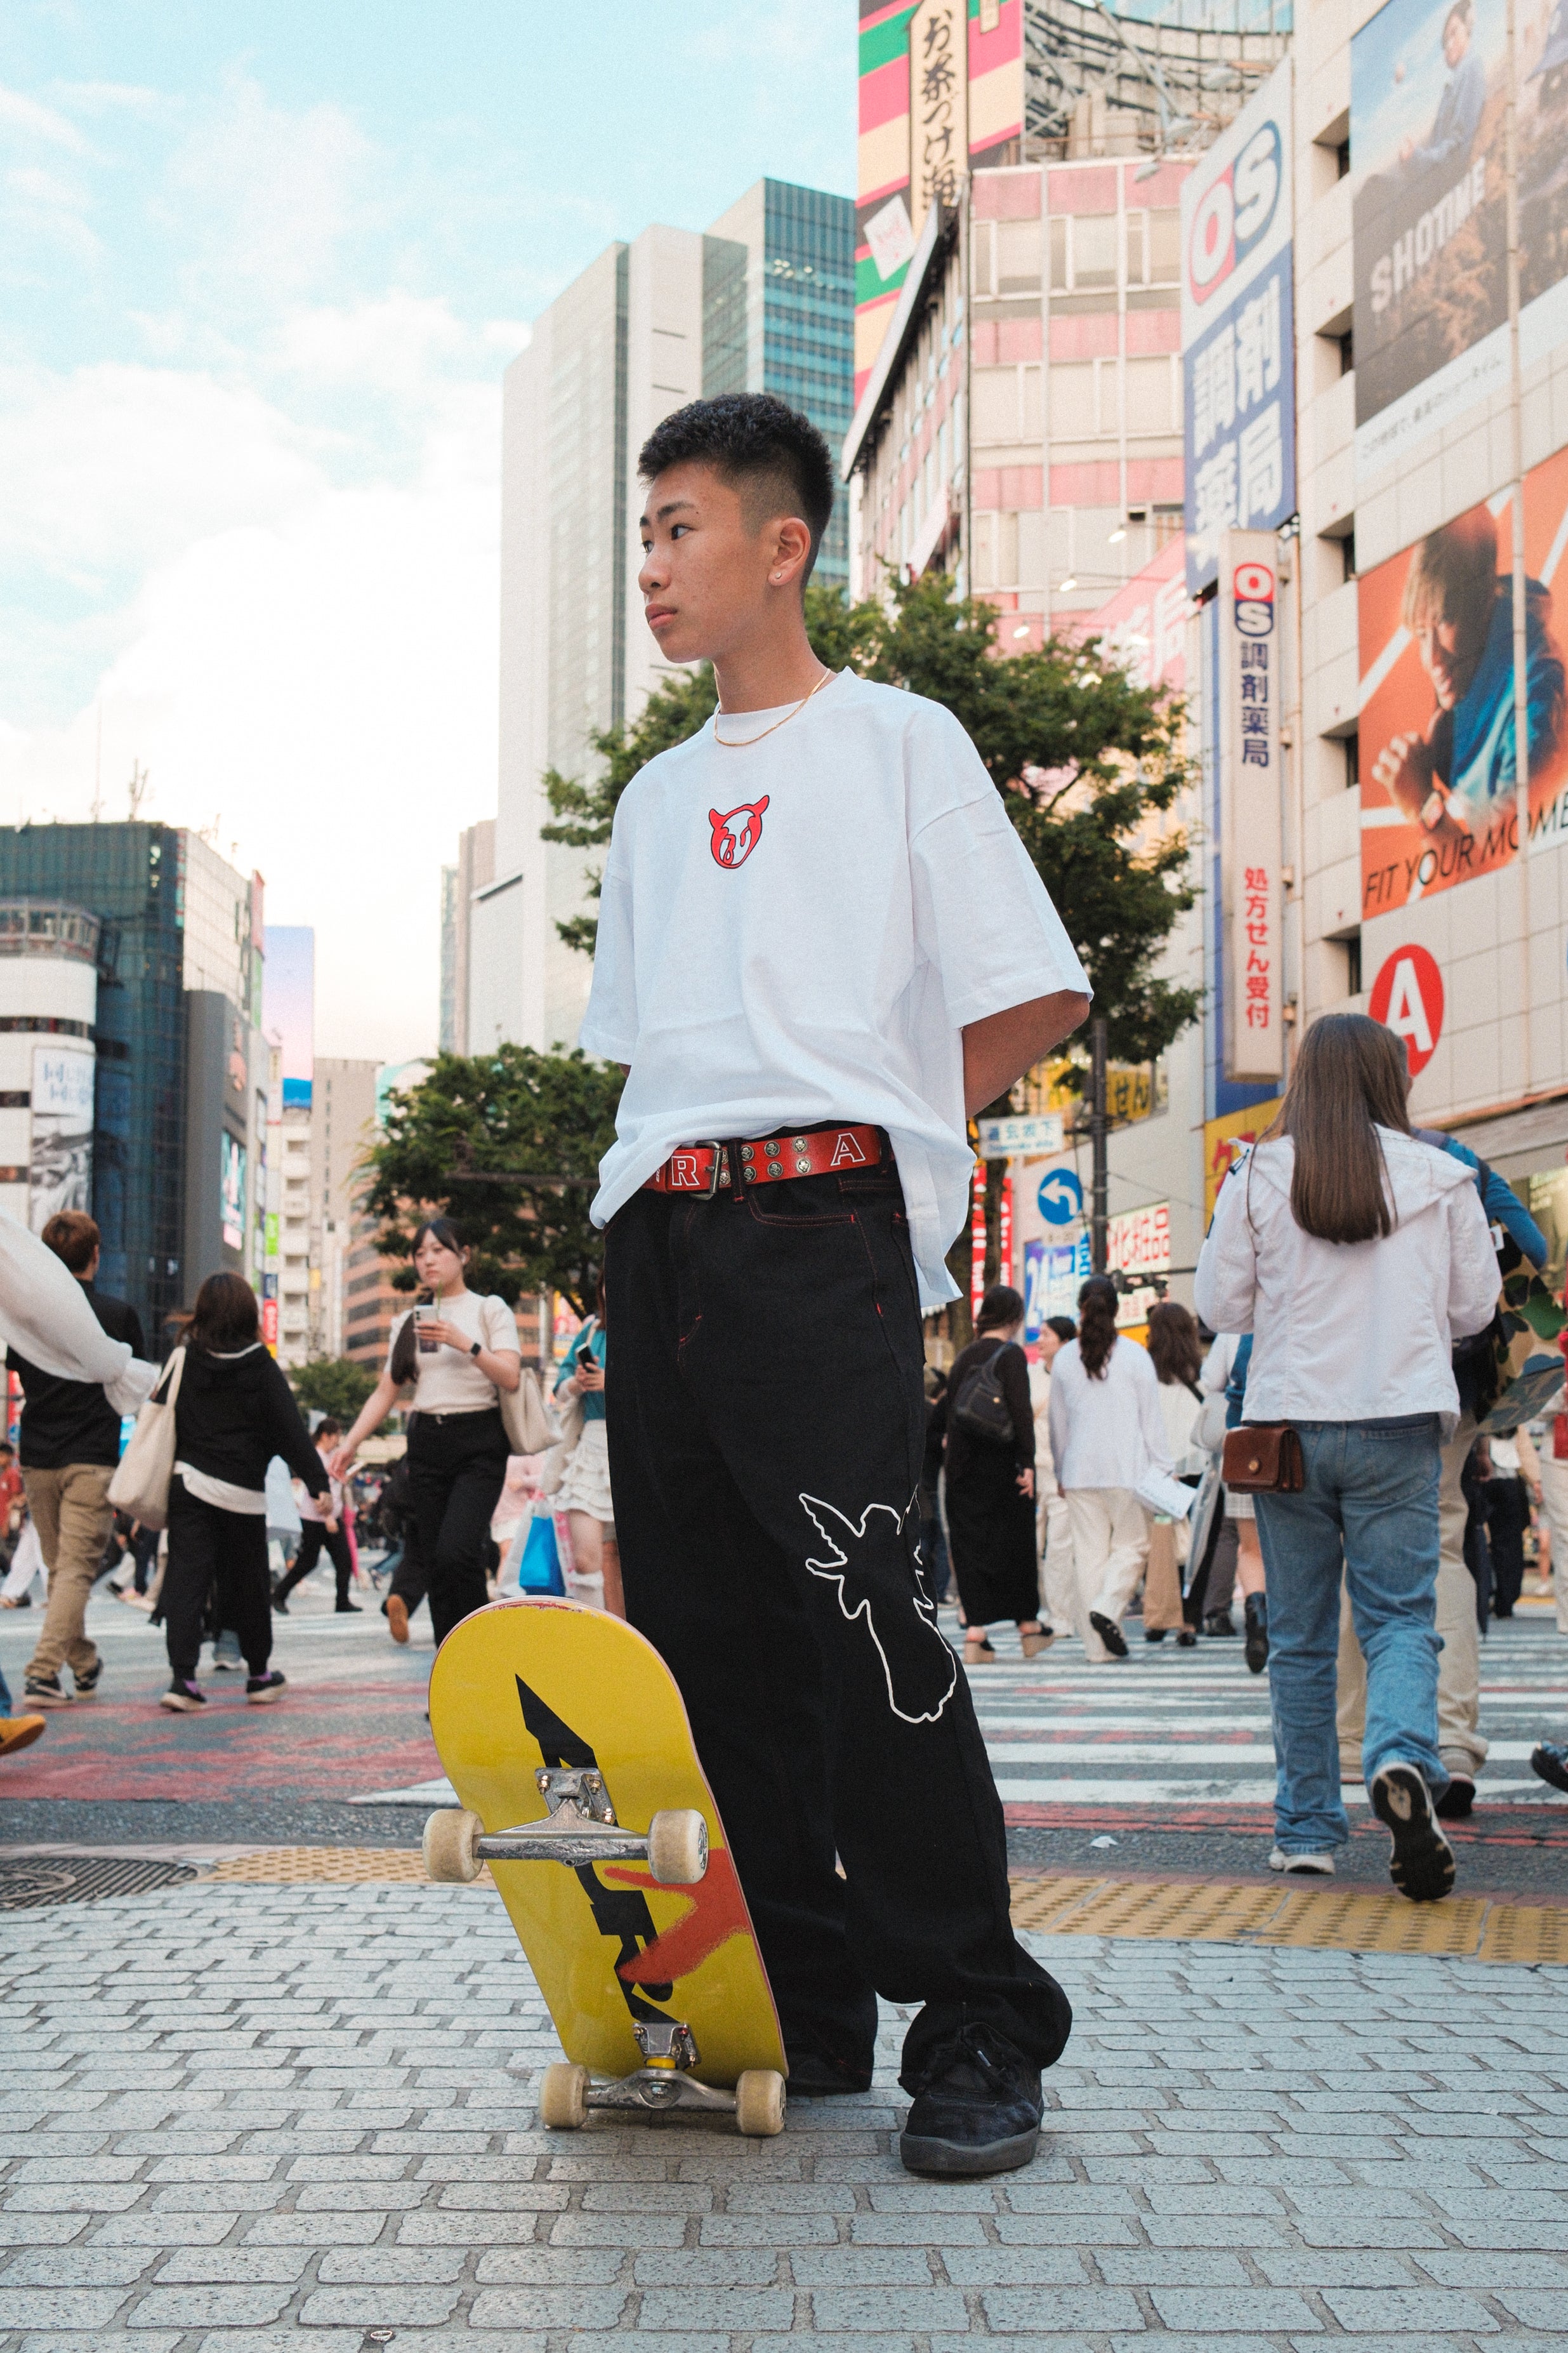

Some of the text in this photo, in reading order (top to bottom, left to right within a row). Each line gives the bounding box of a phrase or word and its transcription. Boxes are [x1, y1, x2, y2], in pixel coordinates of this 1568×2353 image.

[1190, 123, 1279, 295] OS
[1370, 154, 1486, 314] SHOTIME
[1193, 274, 1282, 460] 調剤
[1234, 564, 1274, 767] OS 調剤薬局
[1245, 867, 1270, 1029] 処方せん受付
[1363, 863, 1399, 910] FIT
[1404, 832, 1475, 895] YOUR
[1385, 957, 1434, 1054] A
[671, 1155, 701, 1186] R
[830, 1132, 867, 1167] A
